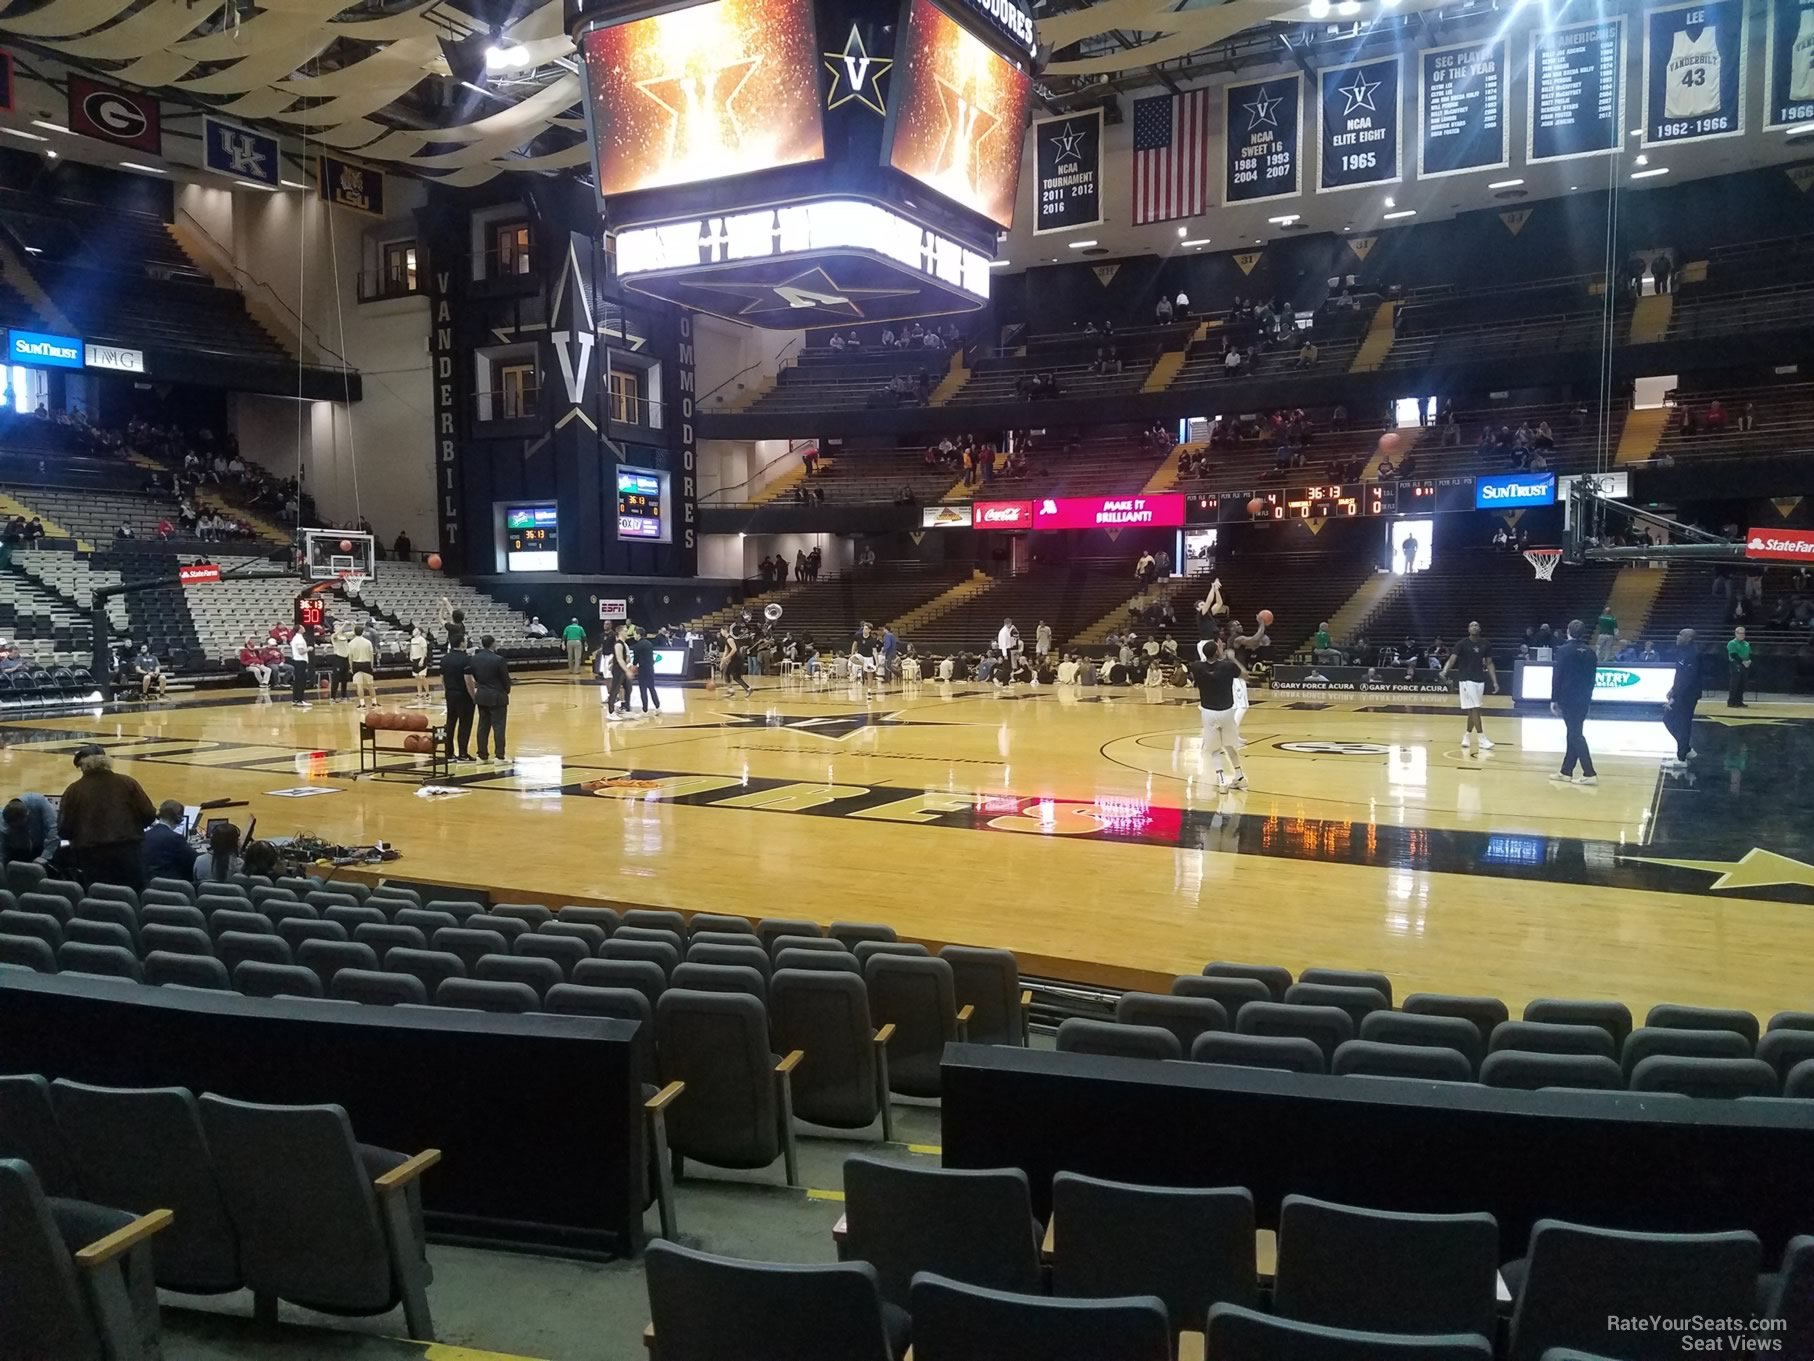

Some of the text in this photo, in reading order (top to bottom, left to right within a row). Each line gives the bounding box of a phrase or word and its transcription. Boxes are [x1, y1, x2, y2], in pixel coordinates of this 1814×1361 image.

[1686, 11, 1704, 25] LEE
[1435, 56, 1454, 68] SEC
[1670, 56, 1718, 72] VANDERBILT
[1433, 61, 1495, 82] OF THE YEAR
[1681, 68, 1706, 87] 43
[1347, 117, 1372, 131] NCAA
[1250, 131, 1273, 145] NCAA
[1333, 128, 1386, 147] ELITE EIGHT
[218, 128, 266, 178] UK
[1241, 141, 1283, 158] SWEET 16
[1058, 162, 1078, 175] NCAA
[1234, 152, 1289, 171] 1988 1993
[1342, 152, 1376, 171] 1965
[1043, 172, 1093, 189] TOURNAMENT
[1234, 165, 1290, 184] 2004 2007
[1043, 184, 1093, 201] 2011 2012
[1043, 202, 1065, 215] 2016
[93, 347, 134, 368] IMG
[438, 272, 458, 543] VANDERBILT
[679, 316, 695, 549] OMMODORES
[1268, 494, 1276, 504] 4
[1308, 486, 1340, 499] 36:13
[1373, 487, 1382, 498] 4
[1103, 499, 1146, 511] MAKE IT
[1301, 503, 1356, 518] 0 1 0
[1373, 501, 1381, 513] 0
[1096, 511, 1152, 523] BRILLIANT!
[1275, 507, 1283, 518] 0
[526, 529, 545, 539] 36:13
[515, 540, 521, 549] 0
[300, 600, 323, 609] 36:13
[601, 603, 624, 613] ESPN
[303, 609, 319, 623] 30
[1595, 671, 1630, 683] NTRY
